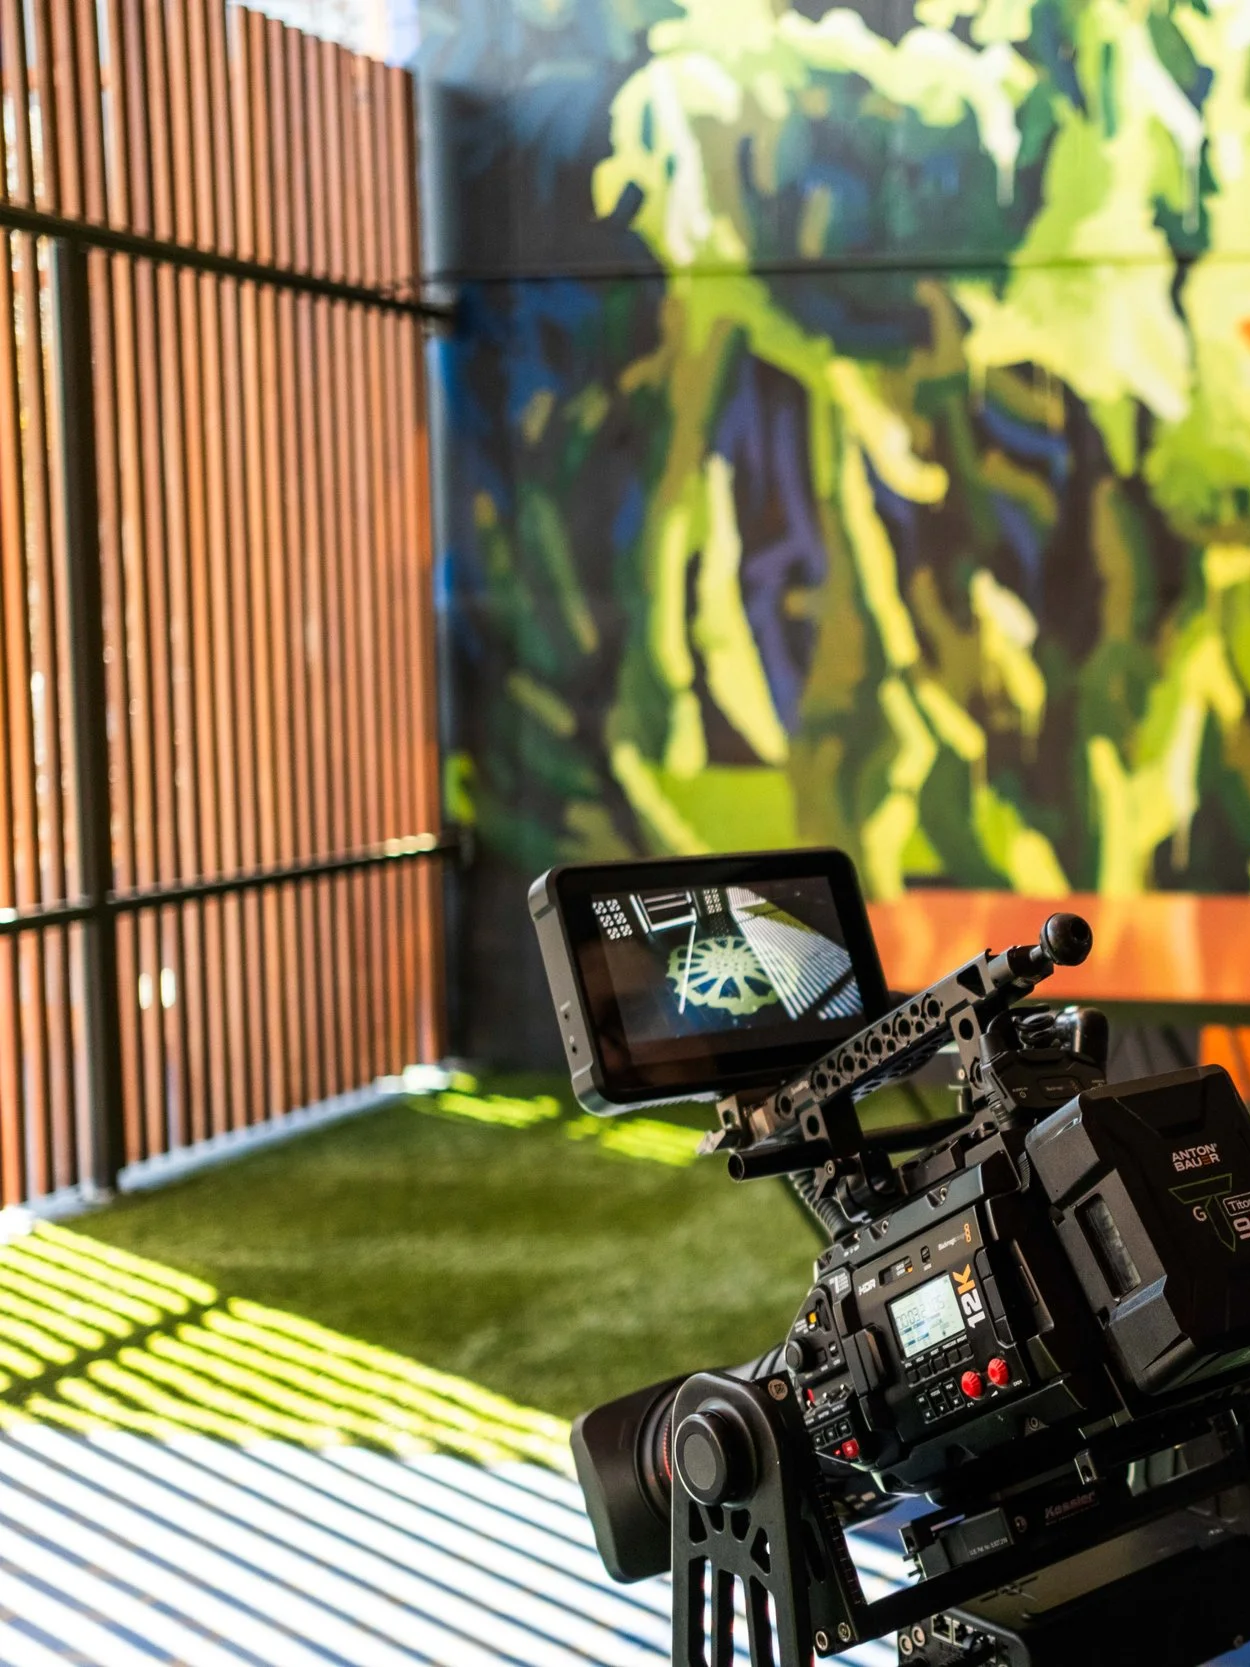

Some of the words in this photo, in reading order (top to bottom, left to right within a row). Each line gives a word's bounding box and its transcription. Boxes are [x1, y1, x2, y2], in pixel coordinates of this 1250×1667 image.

[1172, 1143, 1217, 1162] ANTON
[1174, 1153, 1221, 1172] BAUER
[952, 1264, 986, 1328] 12K
